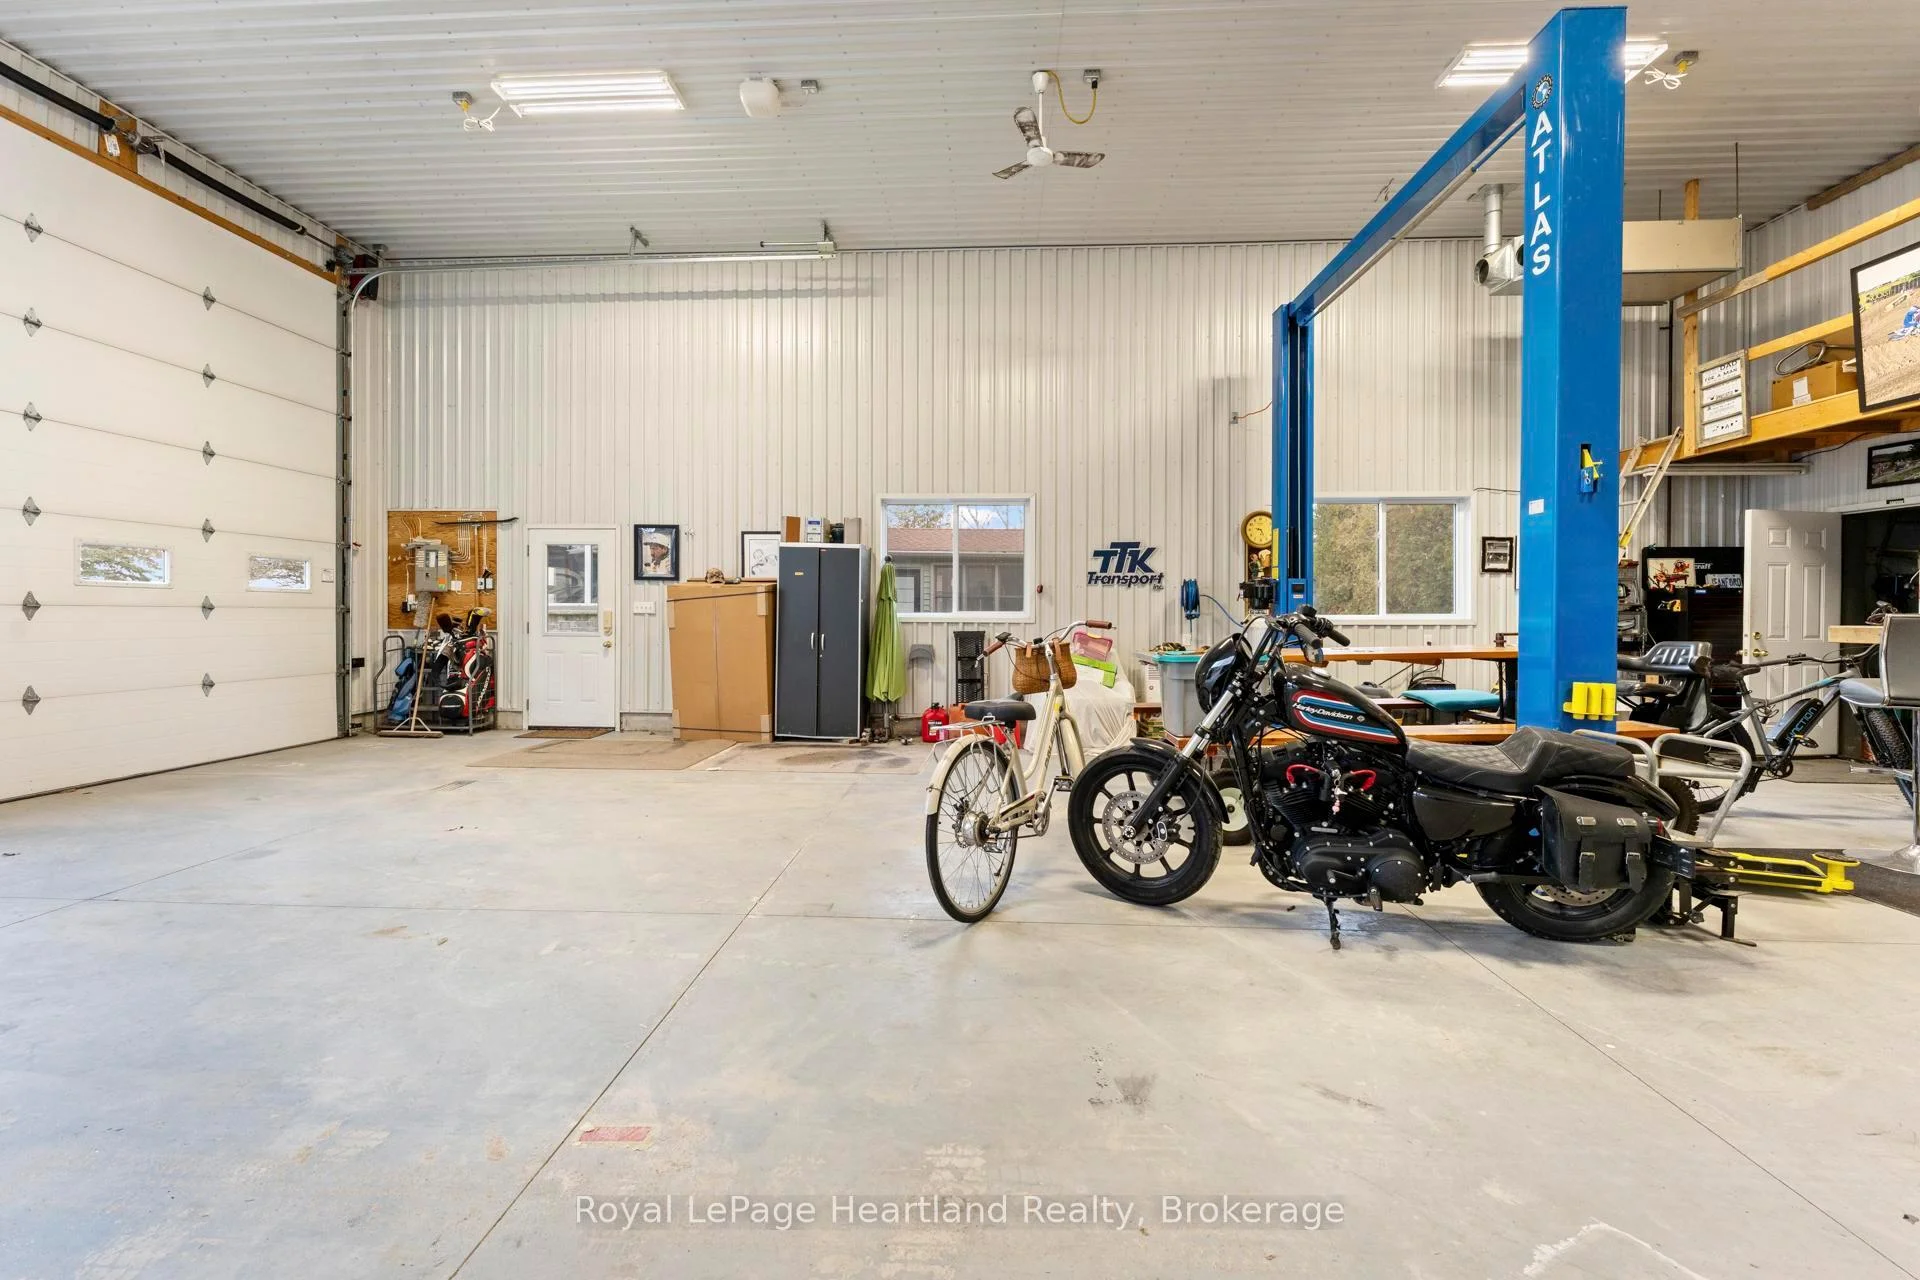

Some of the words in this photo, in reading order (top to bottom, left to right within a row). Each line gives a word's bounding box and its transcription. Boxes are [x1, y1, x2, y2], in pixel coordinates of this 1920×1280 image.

[1530, 110, 1553, 276] ATLAS
[1093, 541, 1156, 573] TTK
[1087, 571, 1164, 588] Transport
